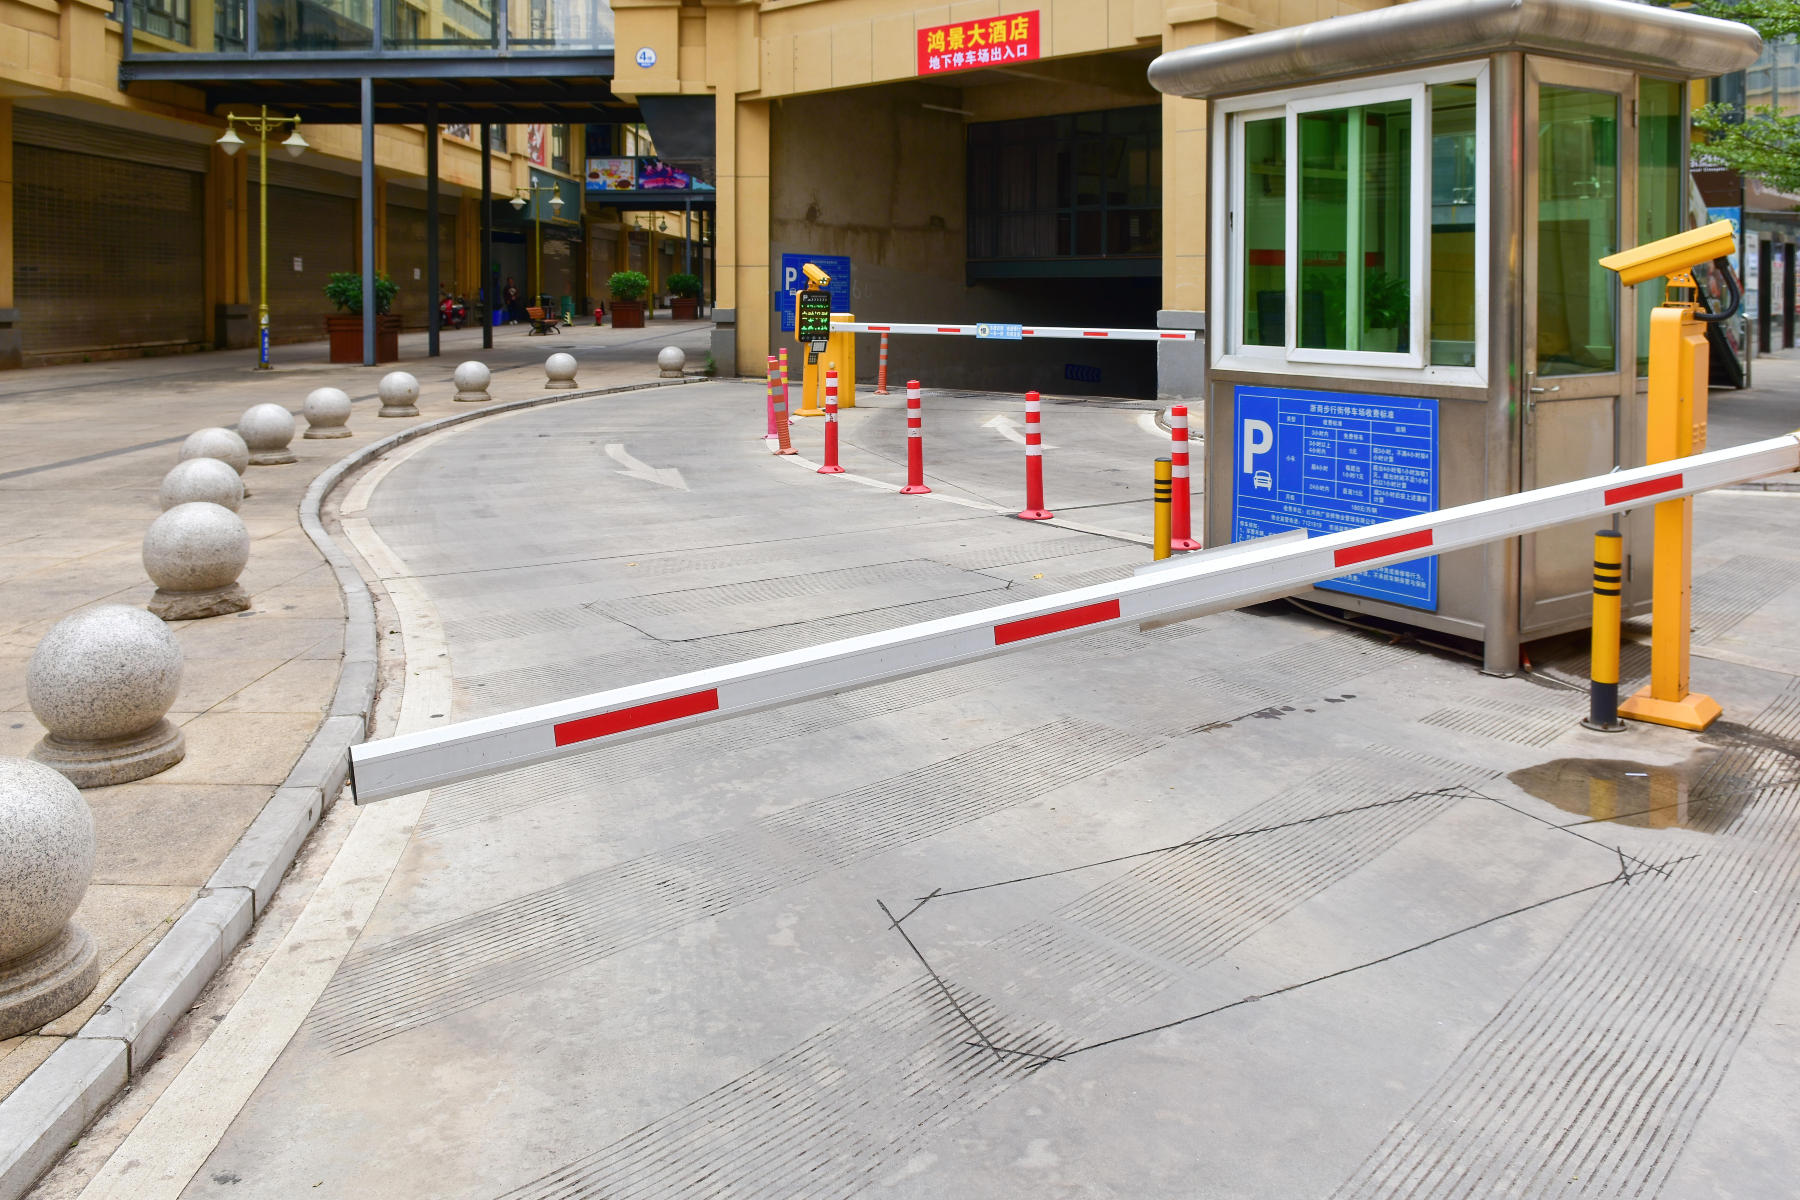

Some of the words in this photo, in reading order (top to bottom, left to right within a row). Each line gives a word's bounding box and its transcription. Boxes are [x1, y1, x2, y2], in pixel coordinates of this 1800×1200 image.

[928, 16, 1029, 52] 鸿景大酒店
[928, 44, 1028, 70] 地下停车场出入口
[786, 267, 798, 290] P
[1244, 418, 1273, 474] P
